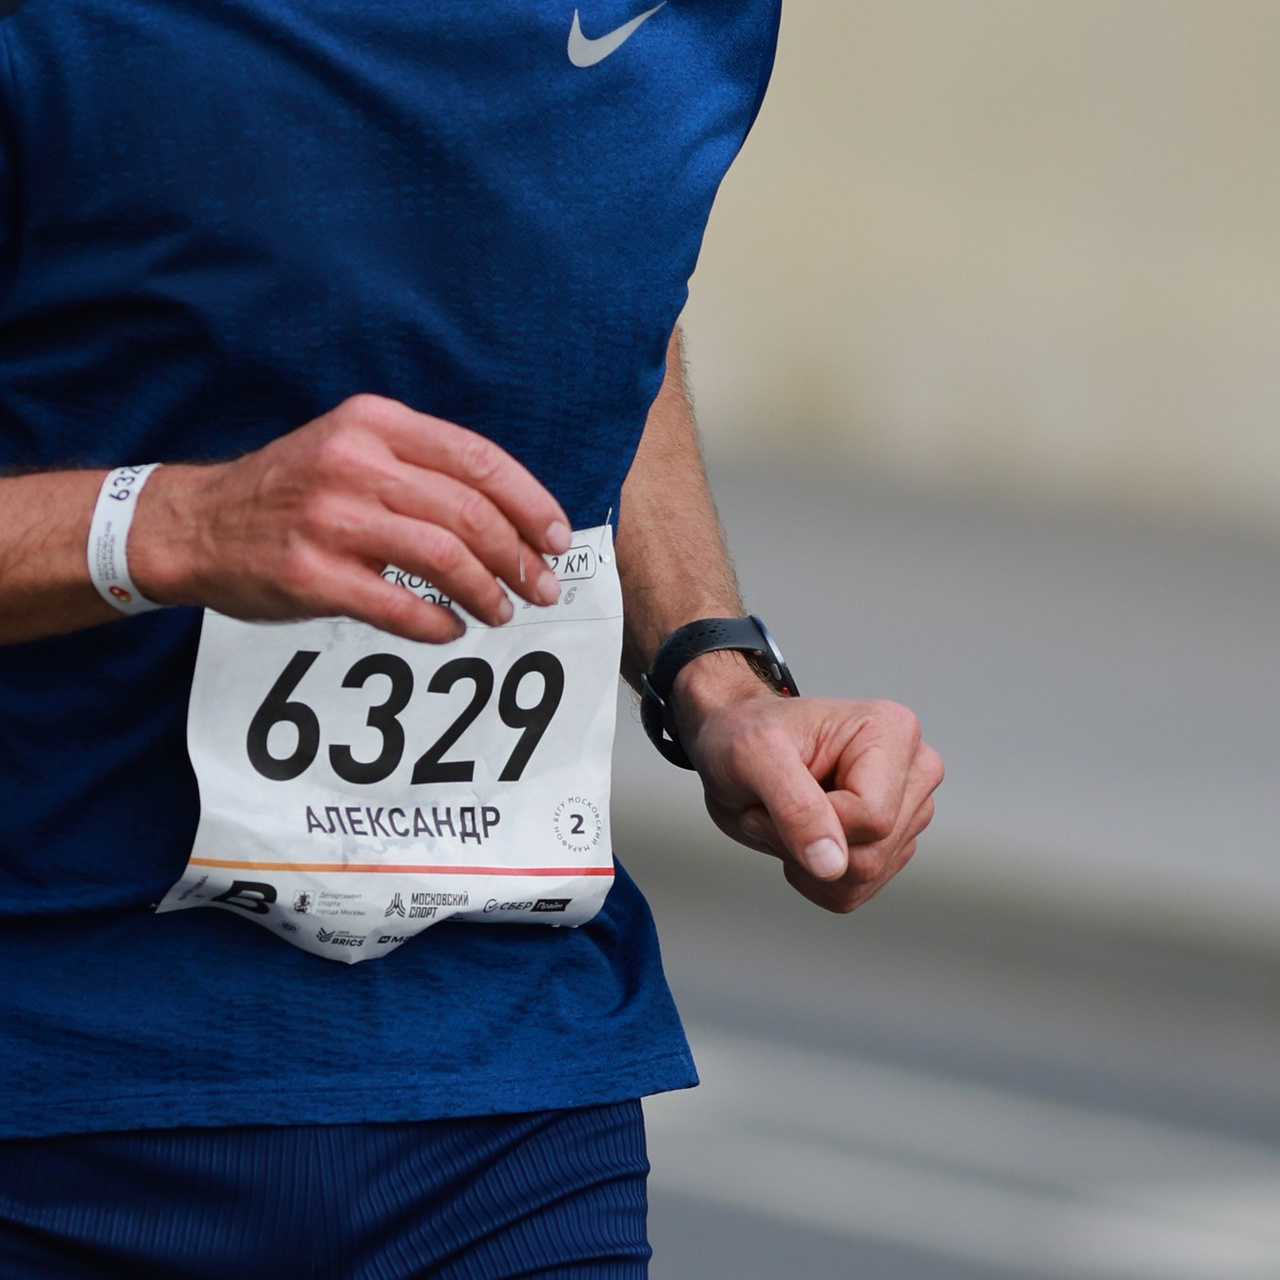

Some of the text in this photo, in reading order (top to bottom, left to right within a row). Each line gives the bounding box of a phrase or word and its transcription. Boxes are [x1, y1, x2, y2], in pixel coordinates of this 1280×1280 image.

[246, 649, 565, 786] 6329
[305, 804, 501, 845] АЛЕКСАНДР
[568, 796, 601, 845] МОСКОВСКИЙ
[570, 813, 585, 834] 2
[554, 826, 590, 852] МАРАФОН
[411, 891, 469, 907] МОСКОВСКИЙ
[500, 901, 533, 911] СБЕР
[409, 907, 438, 918] СПОРТ
[331, 937, 365, 947] BRICS
